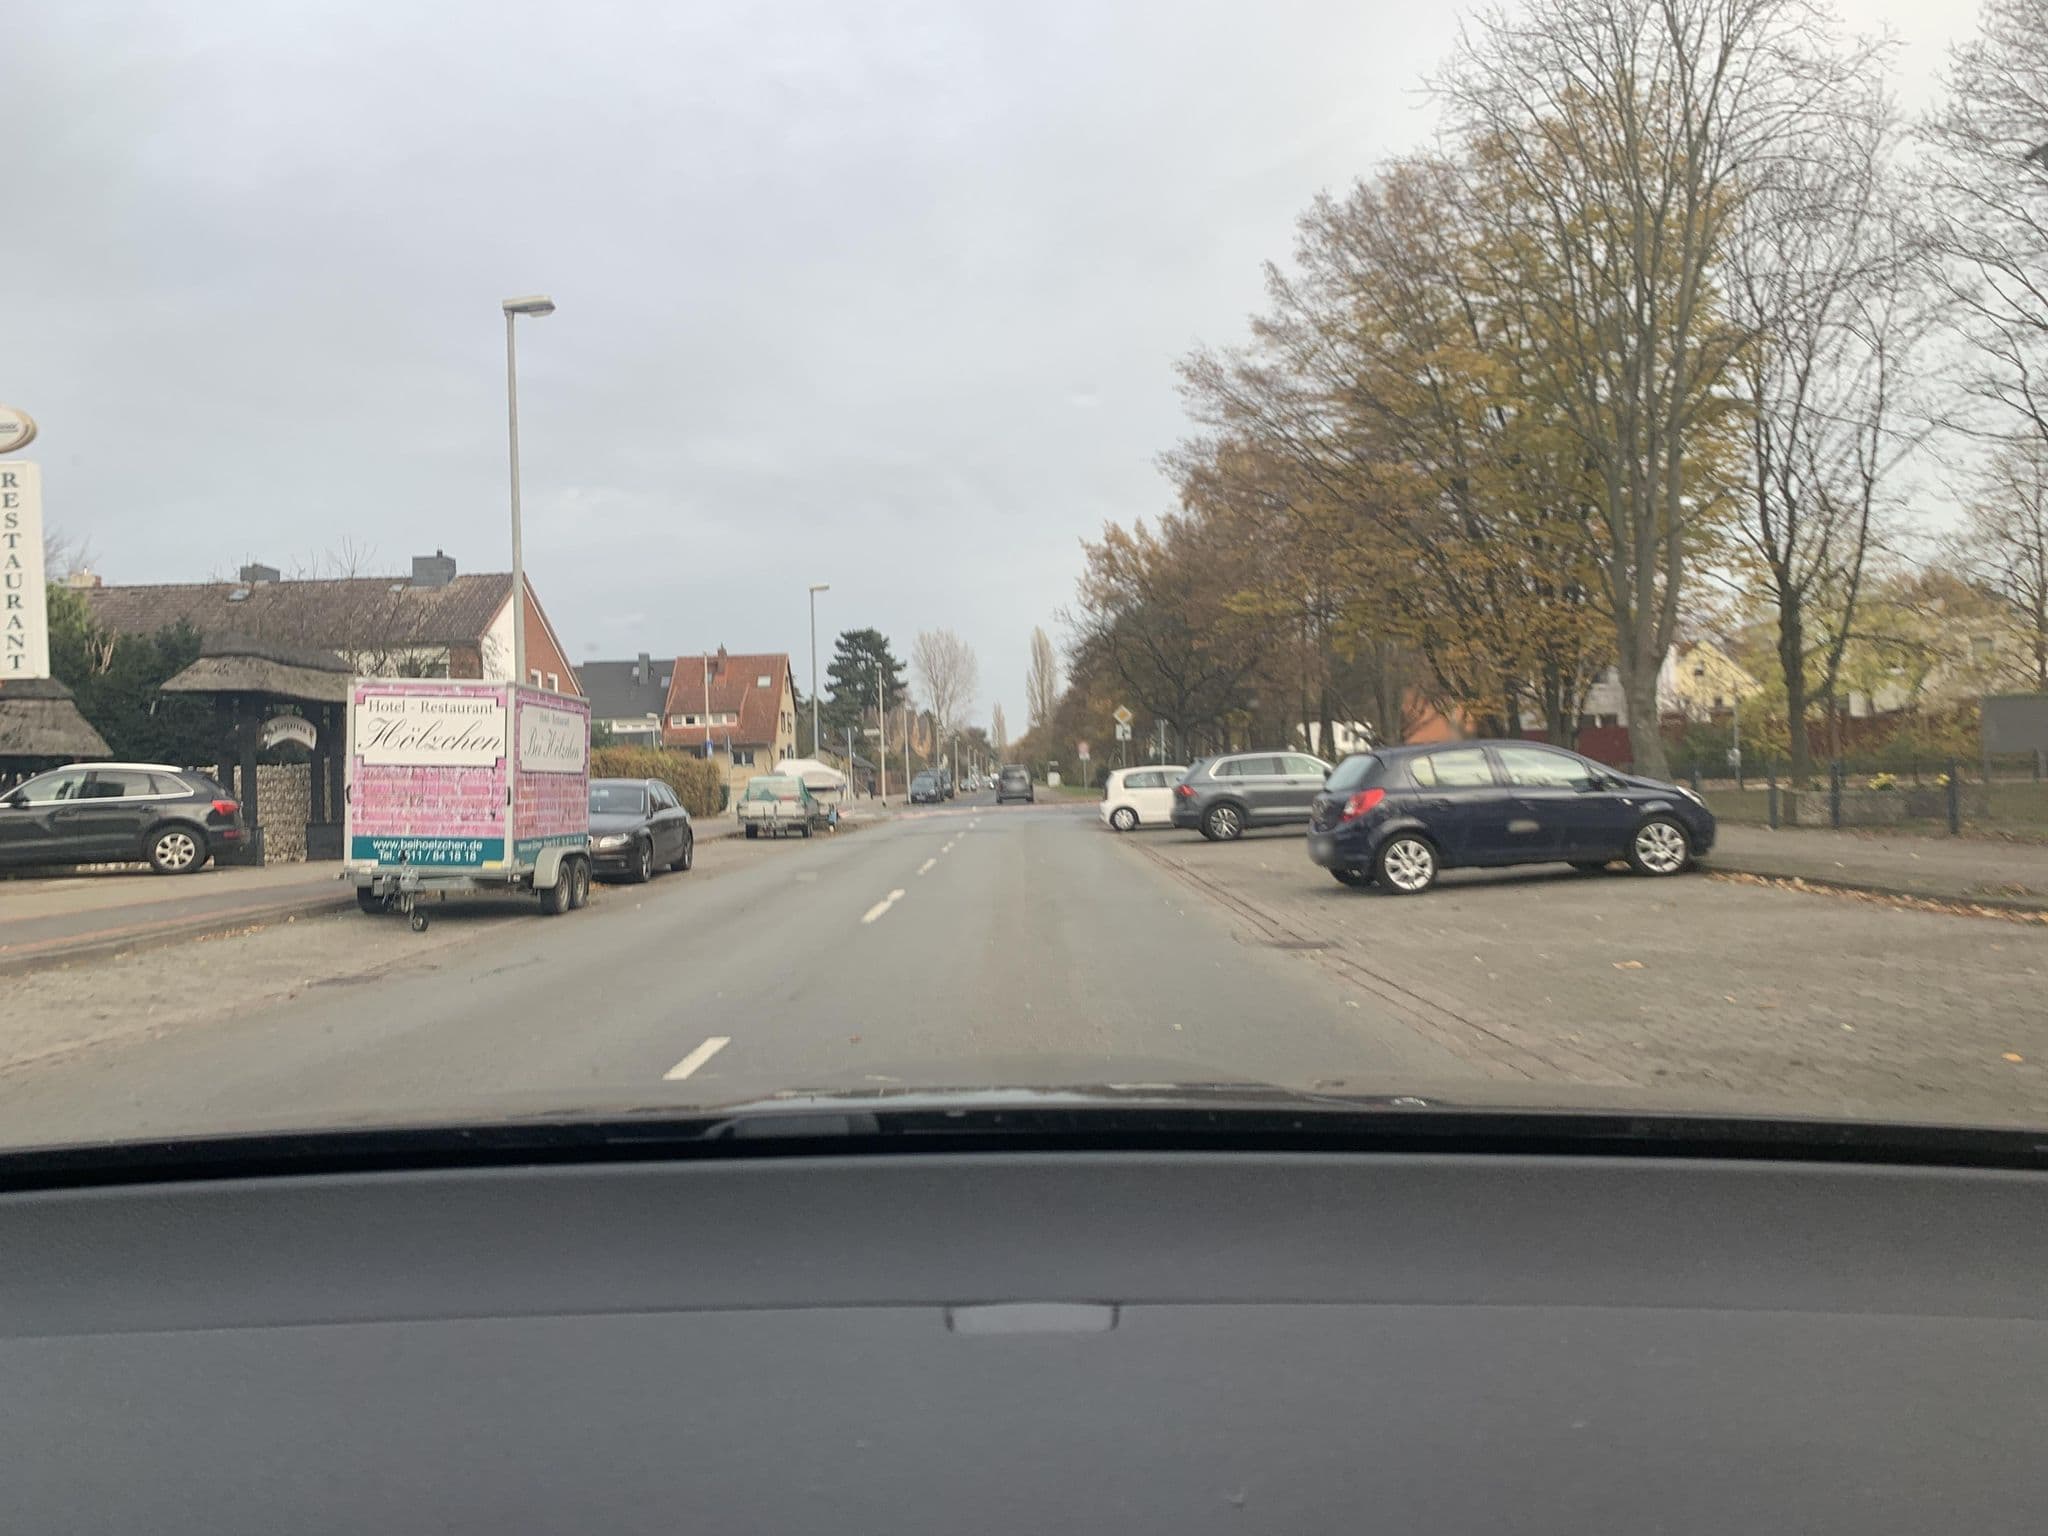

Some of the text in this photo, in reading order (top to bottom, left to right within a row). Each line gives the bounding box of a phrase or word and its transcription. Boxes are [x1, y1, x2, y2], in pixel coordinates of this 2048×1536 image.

[1, 471, 25, 670] RESTAURANT
[368, 699, 405, 713] Hotel
[420, 700, 493, 715] Restaurant
[358, 717, 501, 751] Hölzchen
[379, 849, 395, 861] Tel.
[449, 850, 461, 862] 18
[465, 850, 477, 862] 18
